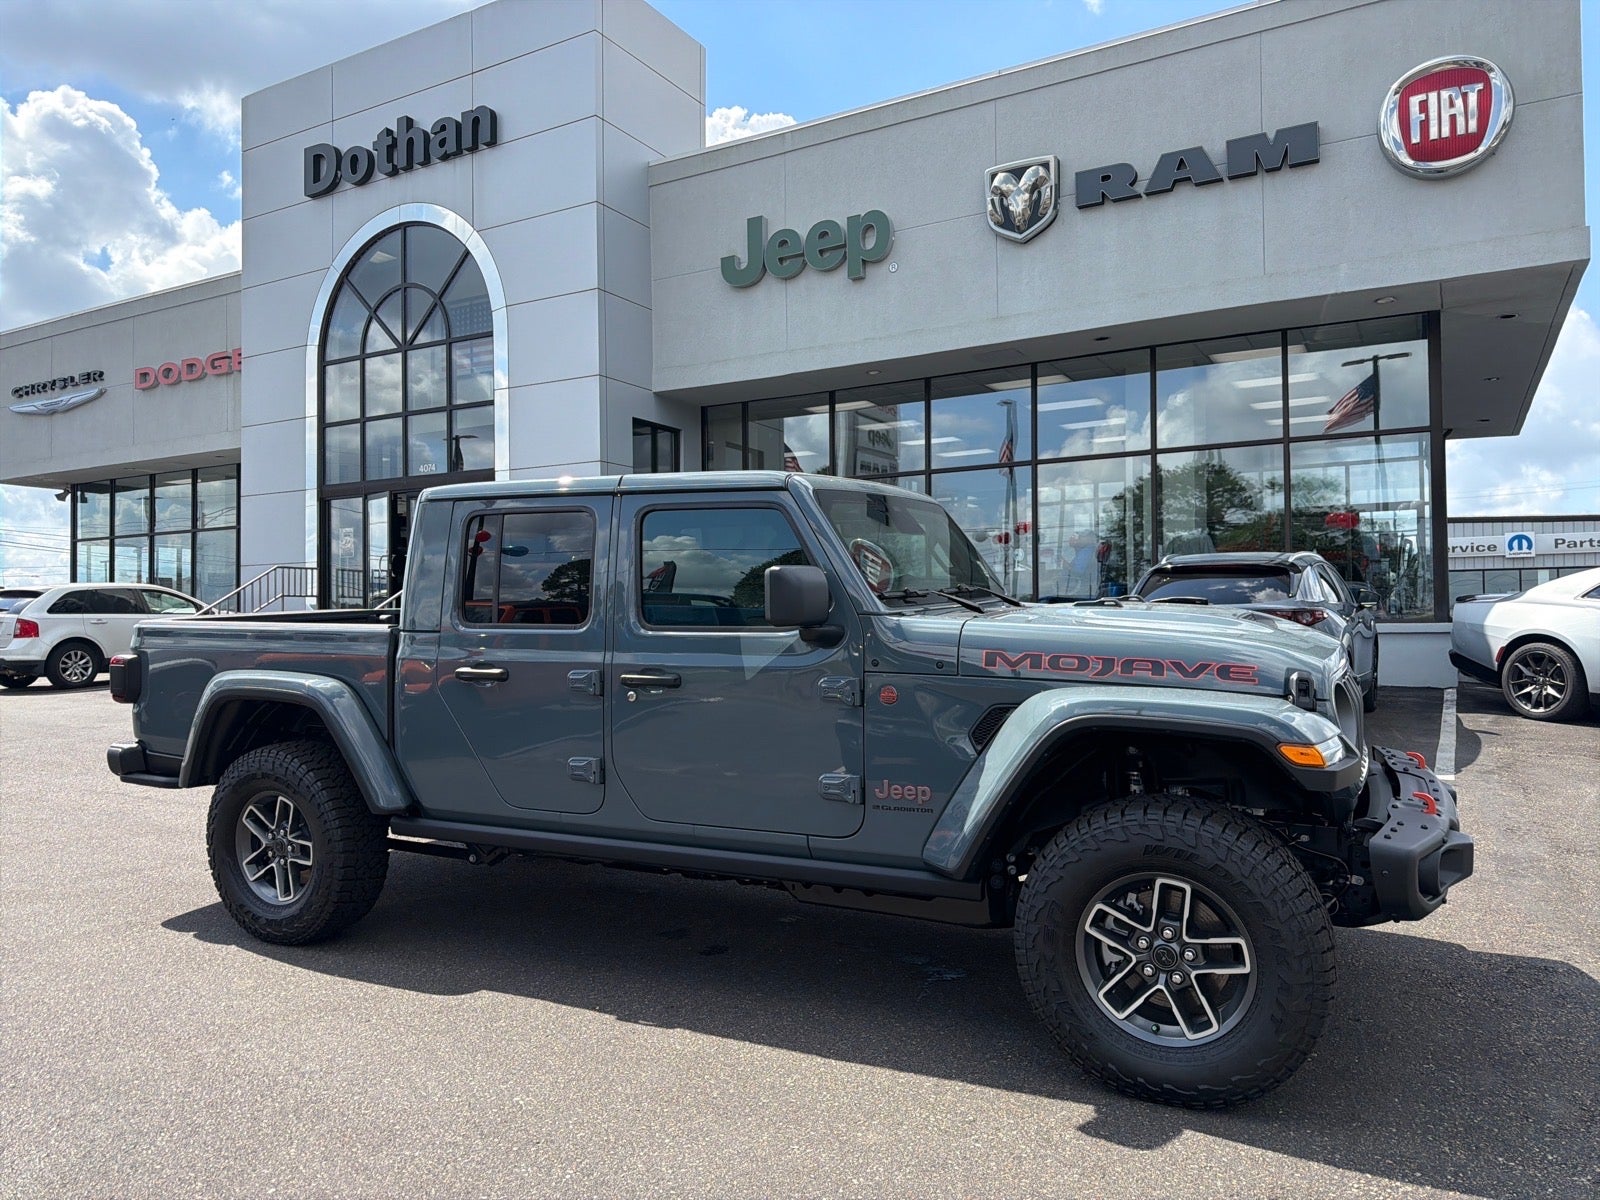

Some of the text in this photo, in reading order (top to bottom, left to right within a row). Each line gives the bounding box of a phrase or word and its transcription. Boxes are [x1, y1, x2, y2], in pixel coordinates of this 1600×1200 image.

[1409, 83, 1484, 144] FIAT
[304, 105, 497, 198] Dothan
[1075, 121, 1320, 209] RAM
[720, 209, 895, 288] Jeep
[11, 370, 105, 399] CHRYSLER
[419, 463, 436, 473] 4074
[1447, 541, 1498, 553] rvice
[1554, 537, 1600, 549] Parts
[982, 650, 1258, 684] MOJAVE
[874, 779, 931, 805] Jeep
[881, 805, 933, 814] GLADIATOR
